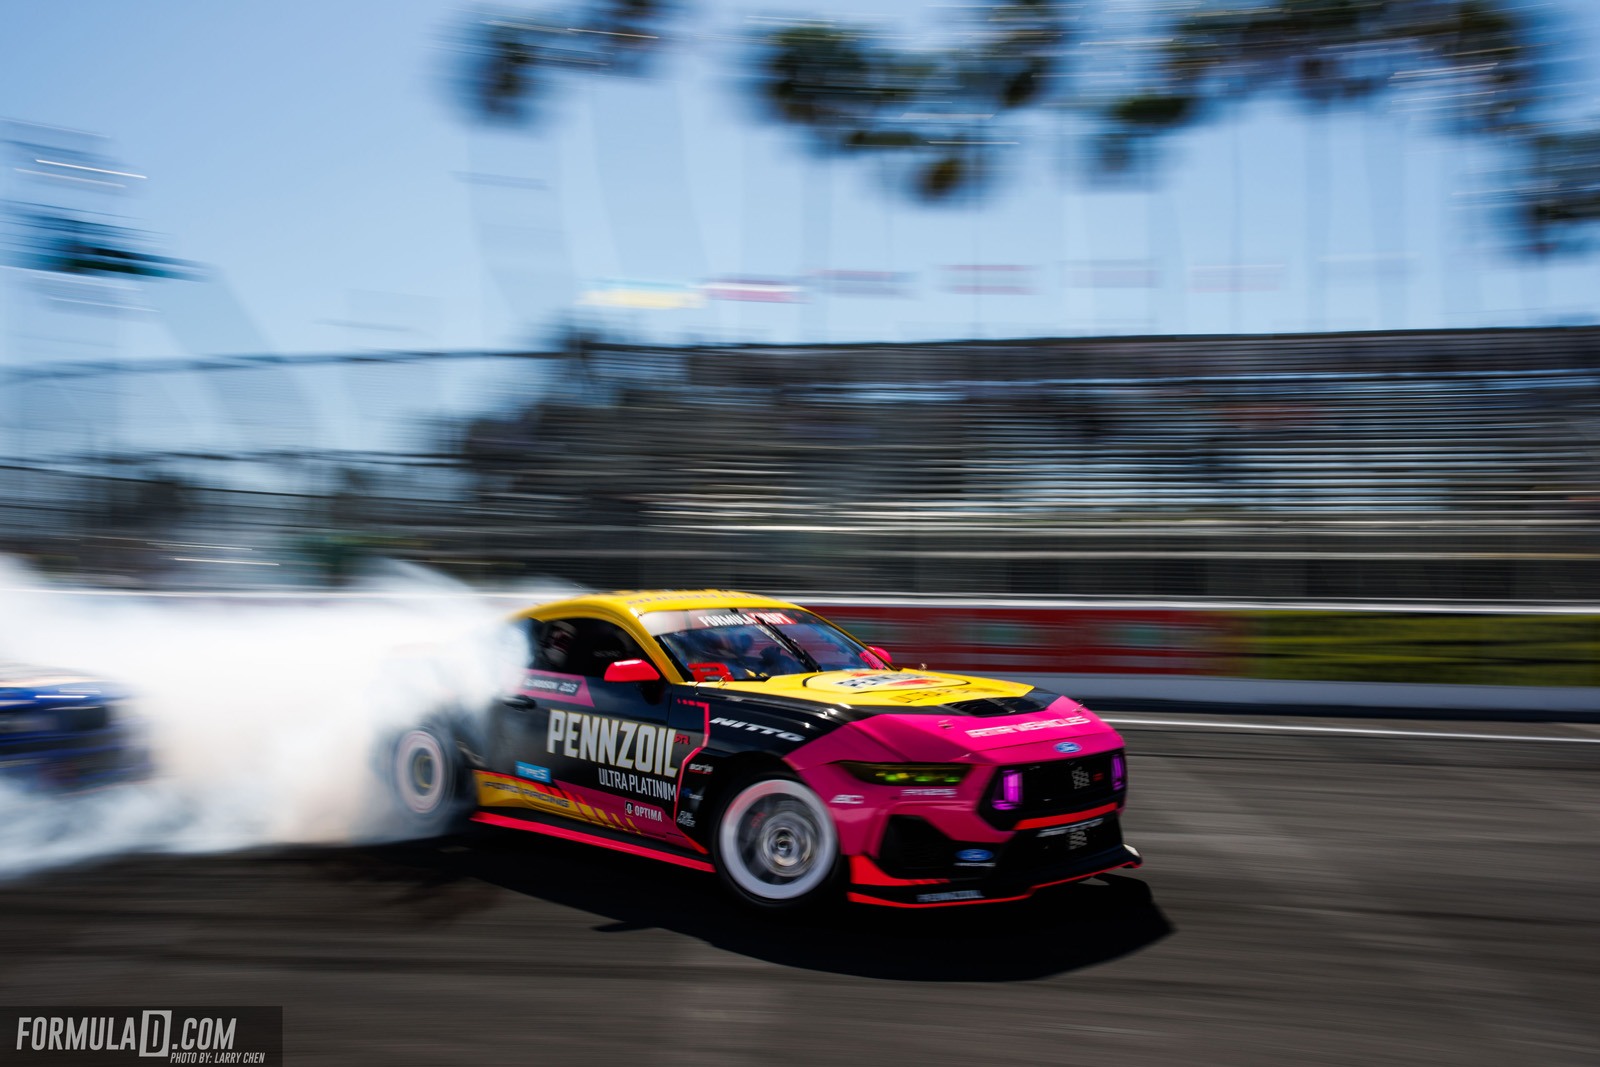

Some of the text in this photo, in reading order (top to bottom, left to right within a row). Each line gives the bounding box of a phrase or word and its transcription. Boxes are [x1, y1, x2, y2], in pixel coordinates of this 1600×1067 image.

[698, 614, 757, 627] FORMULA
[709, 717, 806, 742] NITTO
[547, 709, 678, 778] PENNZOIL
[484, 781, 570, 808] FORD RACING
[598, 767, 677, 802] ULTRA PLATINUM
[634, 805, 663, 822] OPTIMA
